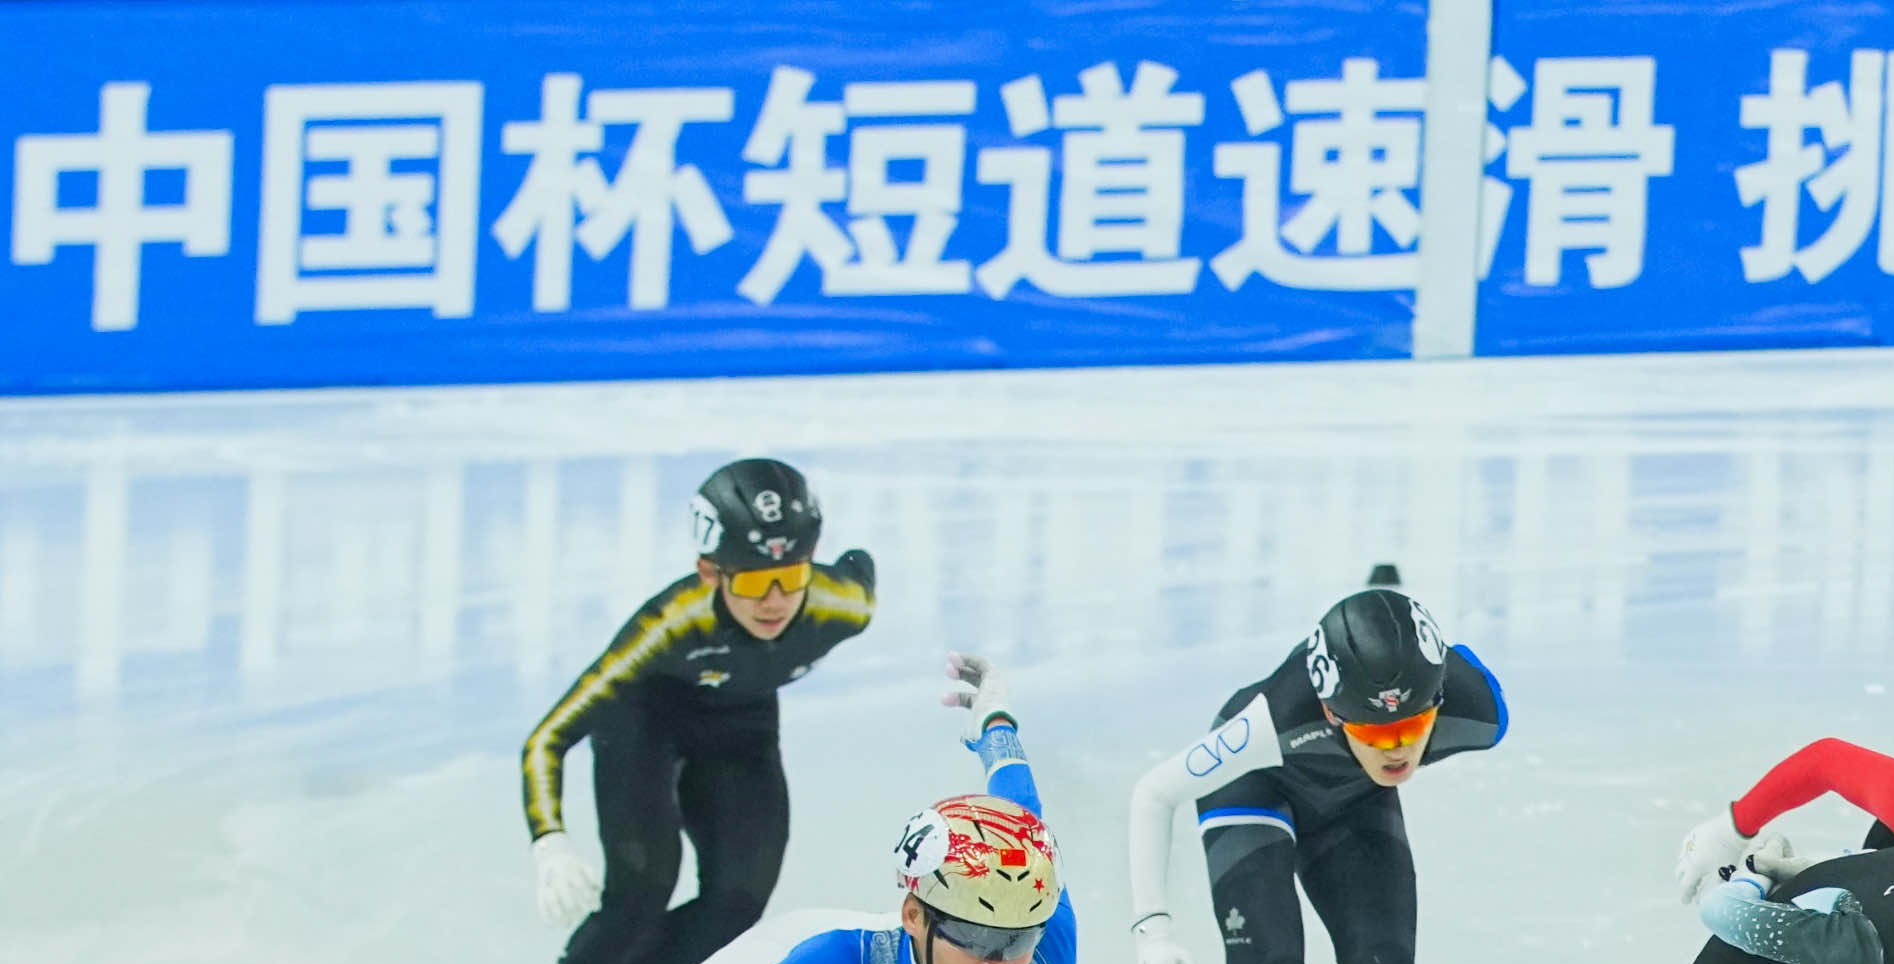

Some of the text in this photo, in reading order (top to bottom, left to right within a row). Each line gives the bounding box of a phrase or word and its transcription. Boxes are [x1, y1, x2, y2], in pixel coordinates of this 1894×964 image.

[12, 56, 1674, 332] 中国杯短道速滑
